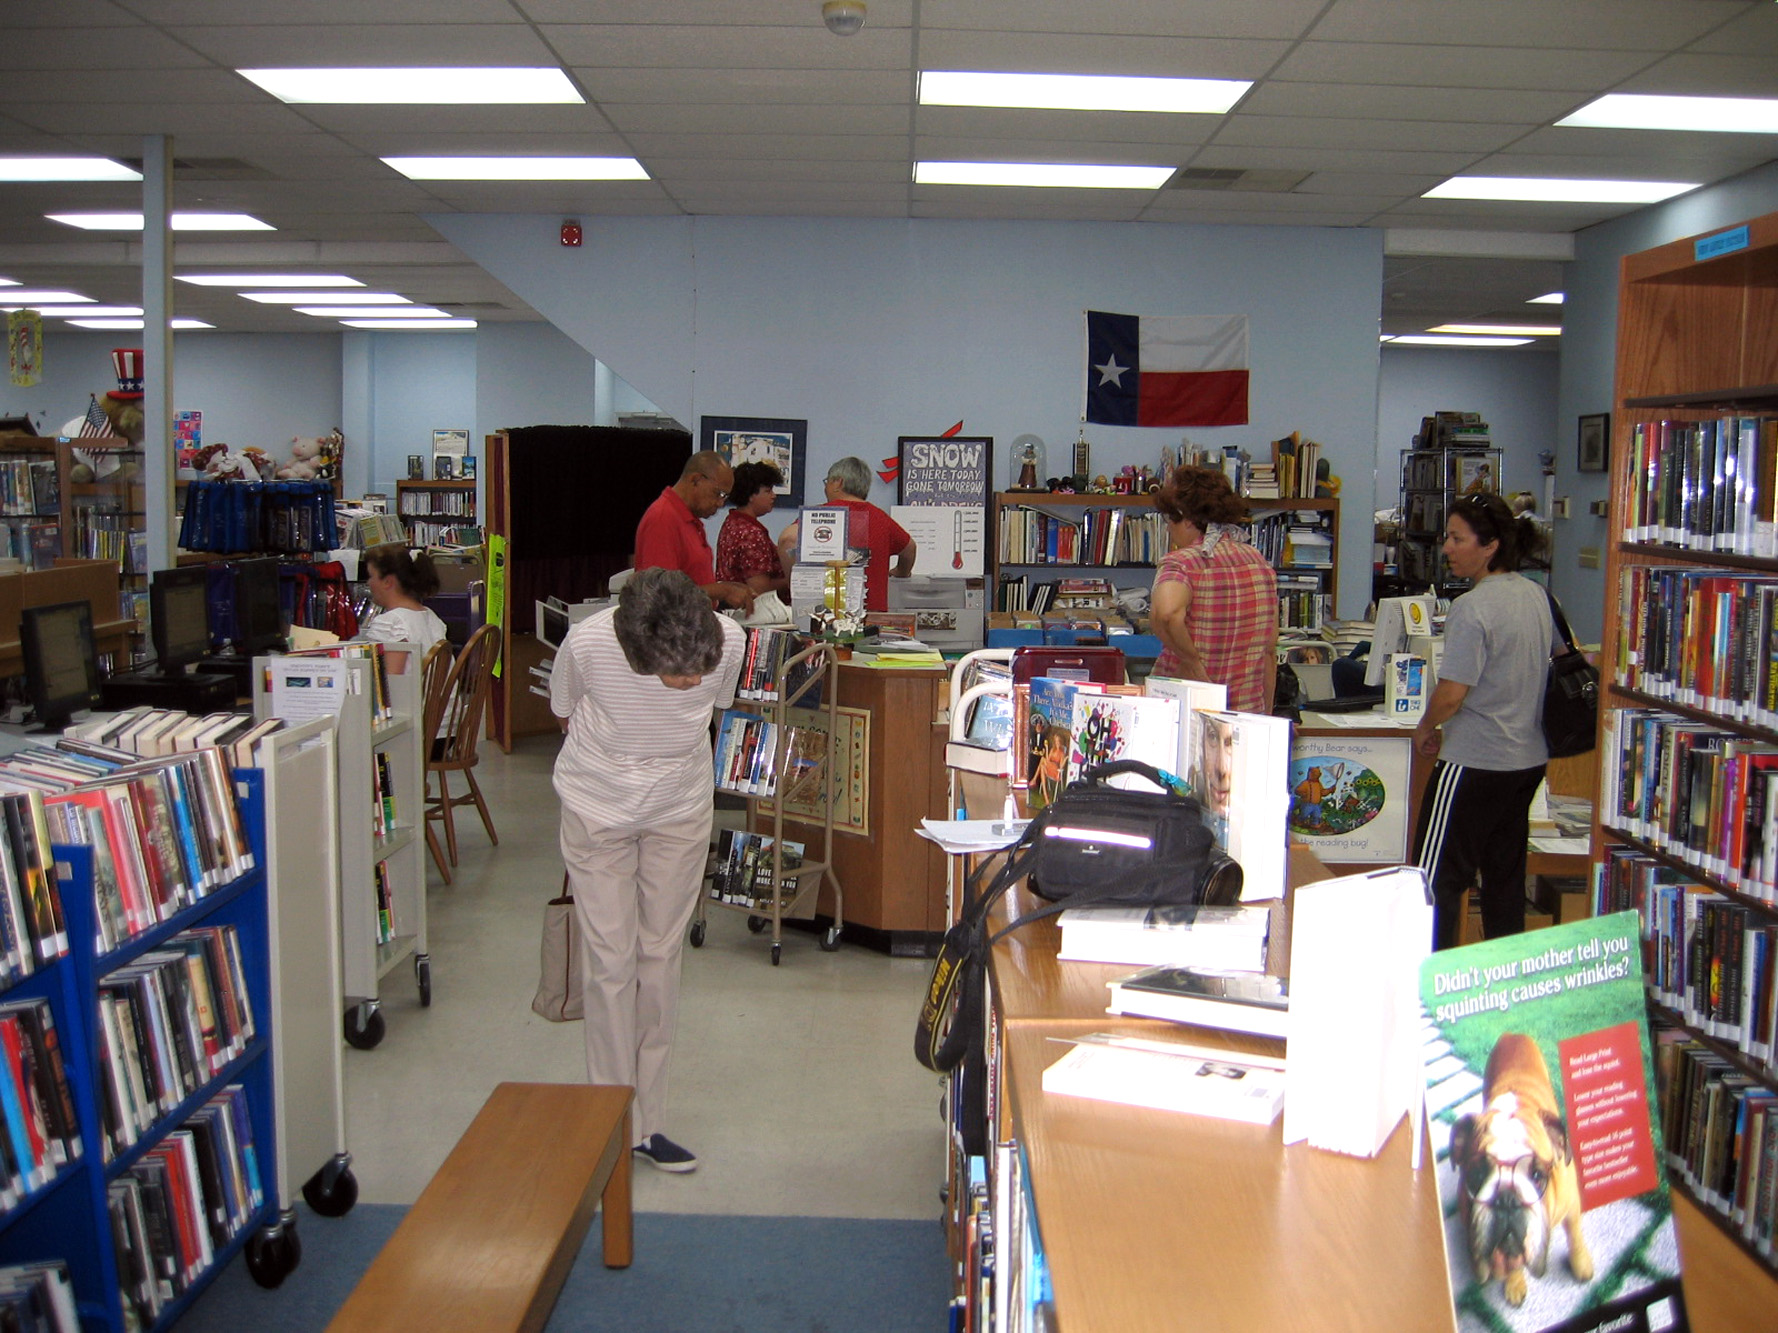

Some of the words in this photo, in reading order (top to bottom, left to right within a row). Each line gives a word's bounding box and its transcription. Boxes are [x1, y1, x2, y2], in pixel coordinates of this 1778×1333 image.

[910, 444, 982, 468] SNOW
[907, 469, 918, 479] IS
[922, 469, 947, 480] HERE
[950, 470, 981, 480] TODAY
[906, 481, 934, 495] GONE
[937, 481, 985, 496] TOMORROW
[1325, 743, 1346, 752] Bear
[1316, 839, 1349, 849] reading
[756, 877, 771, 885] MORE
[1435, 967, 1479, 995] Didn't
[1483, 960, 1518, 988] your
[1522, 949, 1574, 974] mother
[1577, 938, 1599, 959] tell
[1603, 937, 1628, 959] you
[1436, 986, 1508, 1024] squinting
[1512, 977, 1561, 1003] causes
[1565, 957, 1629, 990] wrinkles?
[1583, 1051, 1598, 1064] Large
[1599, 1047, 1612, 1058] Print
[1604, 1081, 1623, 1094] reading
[1595, 1098, 1614, 1110] without
